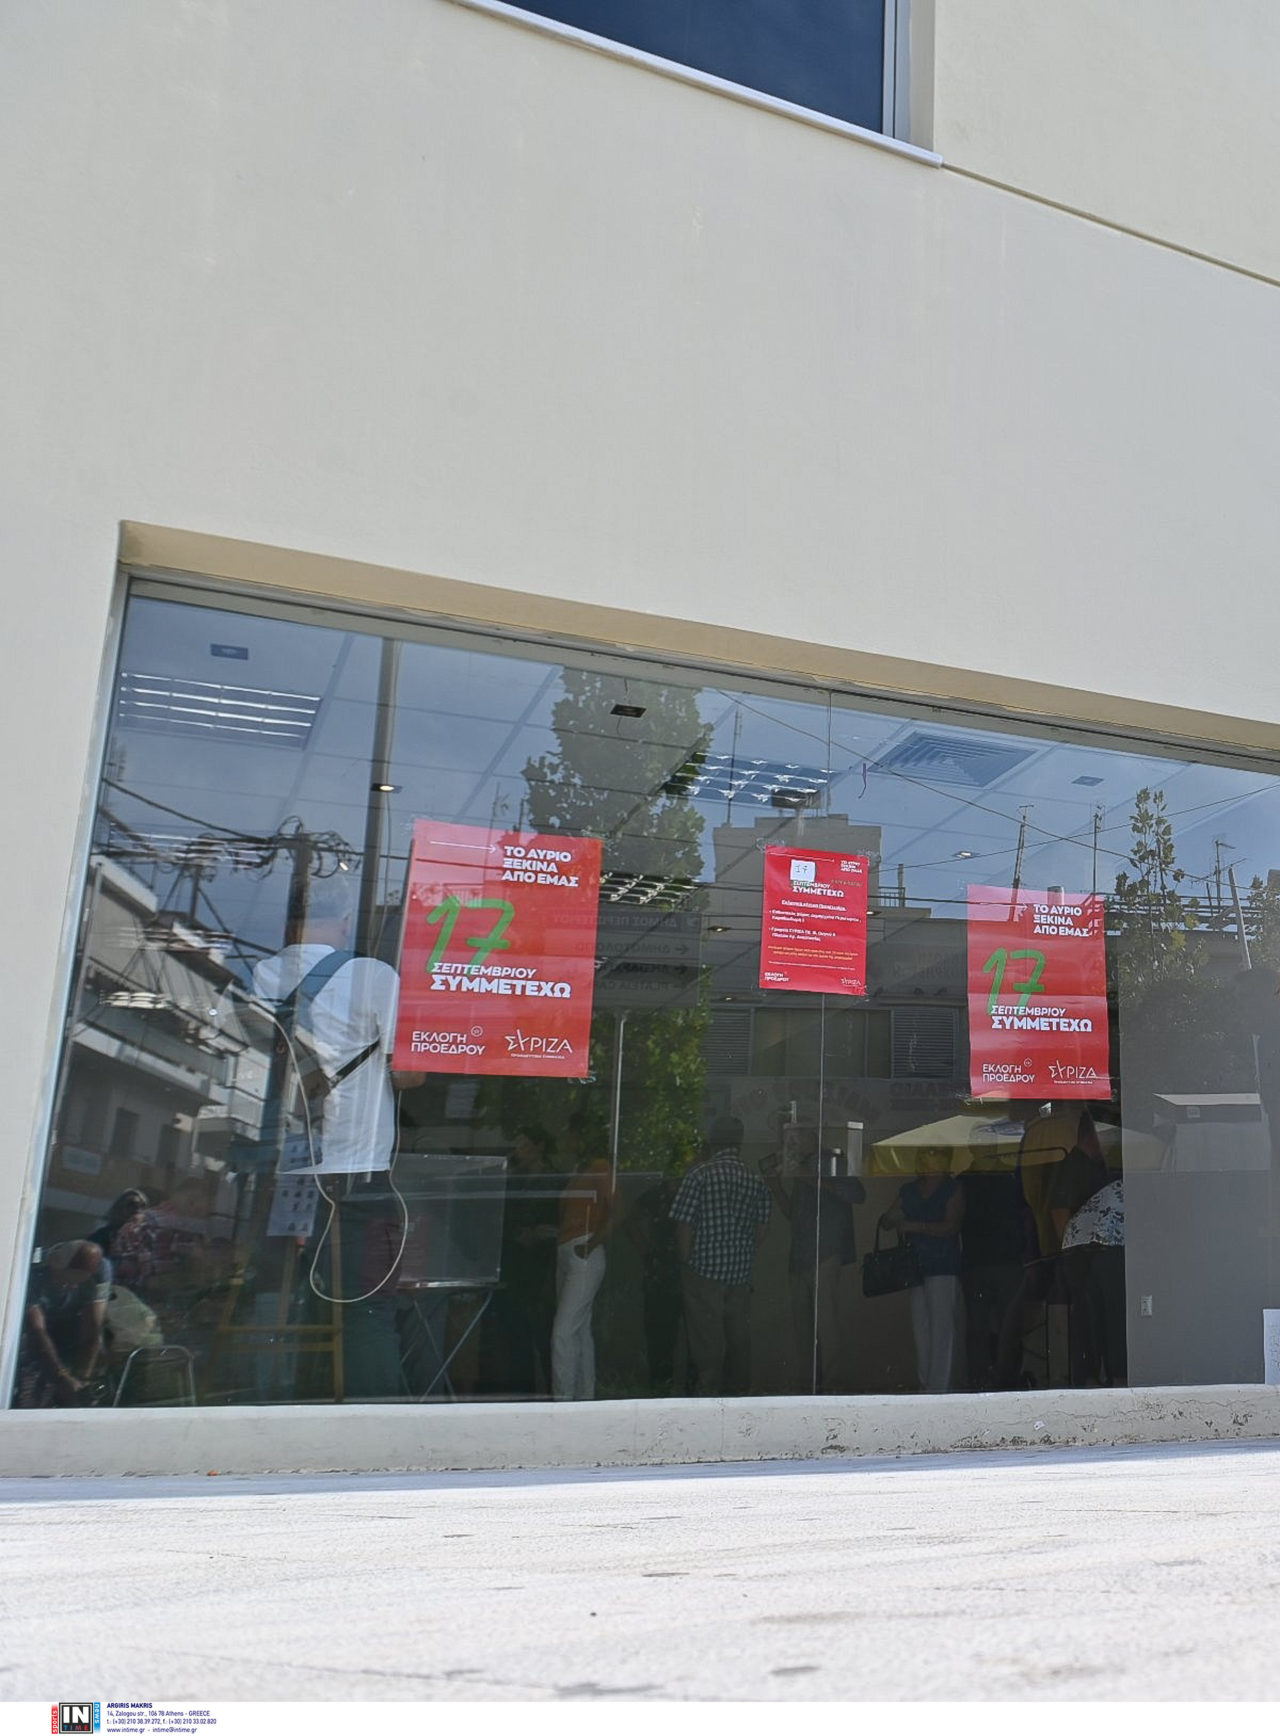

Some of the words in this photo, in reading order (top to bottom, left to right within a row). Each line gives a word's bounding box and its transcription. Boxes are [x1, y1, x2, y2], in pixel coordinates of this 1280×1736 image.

[504, 846, 524, 857] ΤΟ
[527, 848, 572, 862] ΑΥΡΙΟ
[503, 859, 558, 872] ΞΕΚΙΝΑ
[502, 870, 535, 882] ΑΠΟ
[536, 873, 579, 887] ΕΜΑΣ
[792, 886, 845, 898] ΣΥΜΜΕΤΕΧΩ
[1034, 904, 1049, 914] ΤΟ
[1050, 905, 1082, 916] ΑΥΡΙΟ
[1034, 914, 1073, 925] ΞΕΚΙΝΑ
[426, 895, 515, 975] 17
[1033, 924, 1058, 935] ΑΠΟ
[1059, 926, 1090, 937] ΕΜΑΣ
[431, 962, 536, 978] ΣΕΠΤΕΜΒΡΙΟΥ
[430, 974, 571, 998] ΣΥΜΜΕΤΕΧΩ
[982, 947, 1047, 1015] 17
[990, 1005, 1066, 1017] ΣΕΠΤΕΜΒΡΙΟΥ
[991, 1016, 1092, 1032] ΣΥΜΜΕΤΕΧΩ
[412, 1031, 467, 1043] ΕΚΛΟΓΗ
[411, 1042, 485, 1055] ΠΡΟΕΔΡΟΥ
[982, 1064, 1021, 1074] ΕΚΛΟΓΗ
[982, 1073, 1035, 1083] ΠΡΟΕΔΡΟΥ
